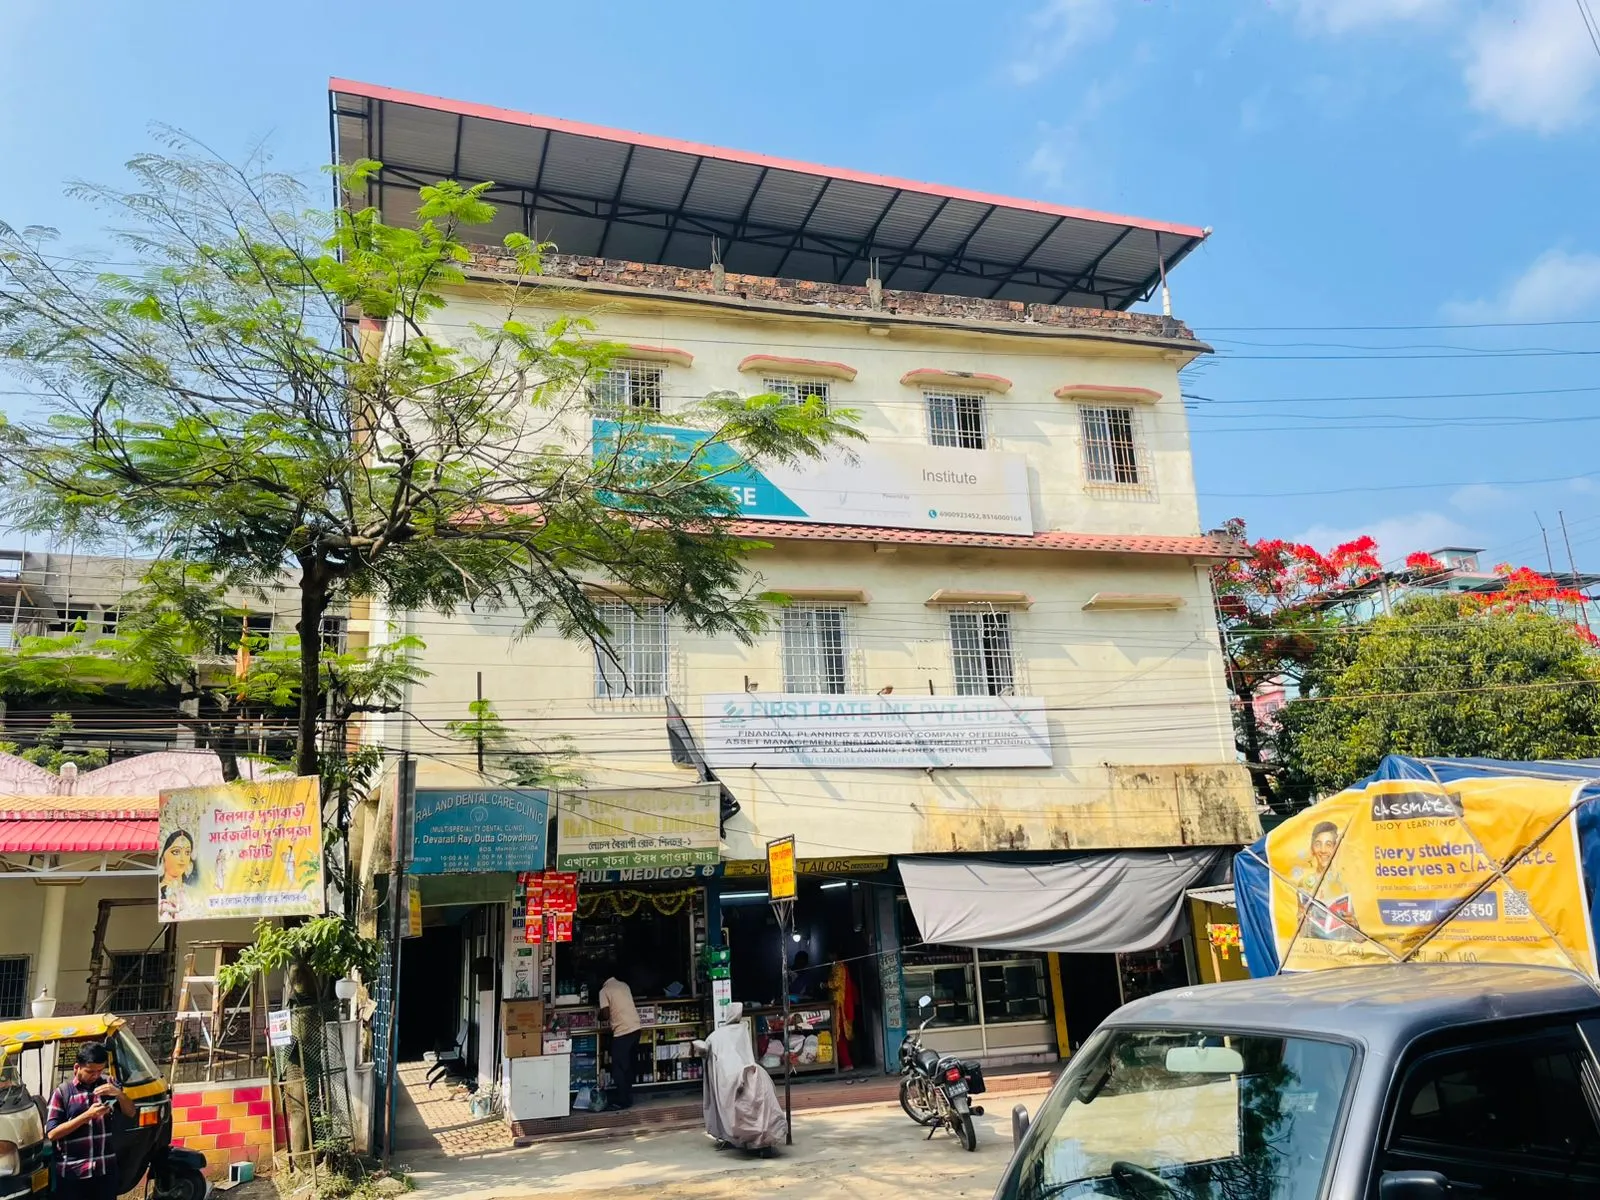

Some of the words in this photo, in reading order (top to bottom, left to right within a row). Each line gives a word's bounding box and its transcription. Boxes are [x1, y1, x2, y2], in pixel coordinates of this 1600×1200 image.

[922, 468, 977, 485] Institute
[750, 701, 812, 721] FIRST
[818, 701, 872, 721] RATE
[738, 730, 793, 738] FINANCIAL
[725, 738, 759, 746] ASSET
[415, 809, 433, 823] RAL
[435, 798, 454, 812] AND
[455, 794, 489, 806] DENTAL
[491, 794, 516, 809] CARE
[516, 802, 543, 824] CLINIC
[1407, 819, 1456, 829] LEARNING
[458, 834, 472, 845] Ray
[497, 833, 540, 843] Chowdhury
[1374, 846, 1415, 862] Every
[801, 860, 850, 873] TAILORS
[1375, 863, 1443, 878] deserves
[1445, 865, 1456, 874] a
[578, 869, 613, 884] HUL
[620, 865, 696, 882] MEDICOS
